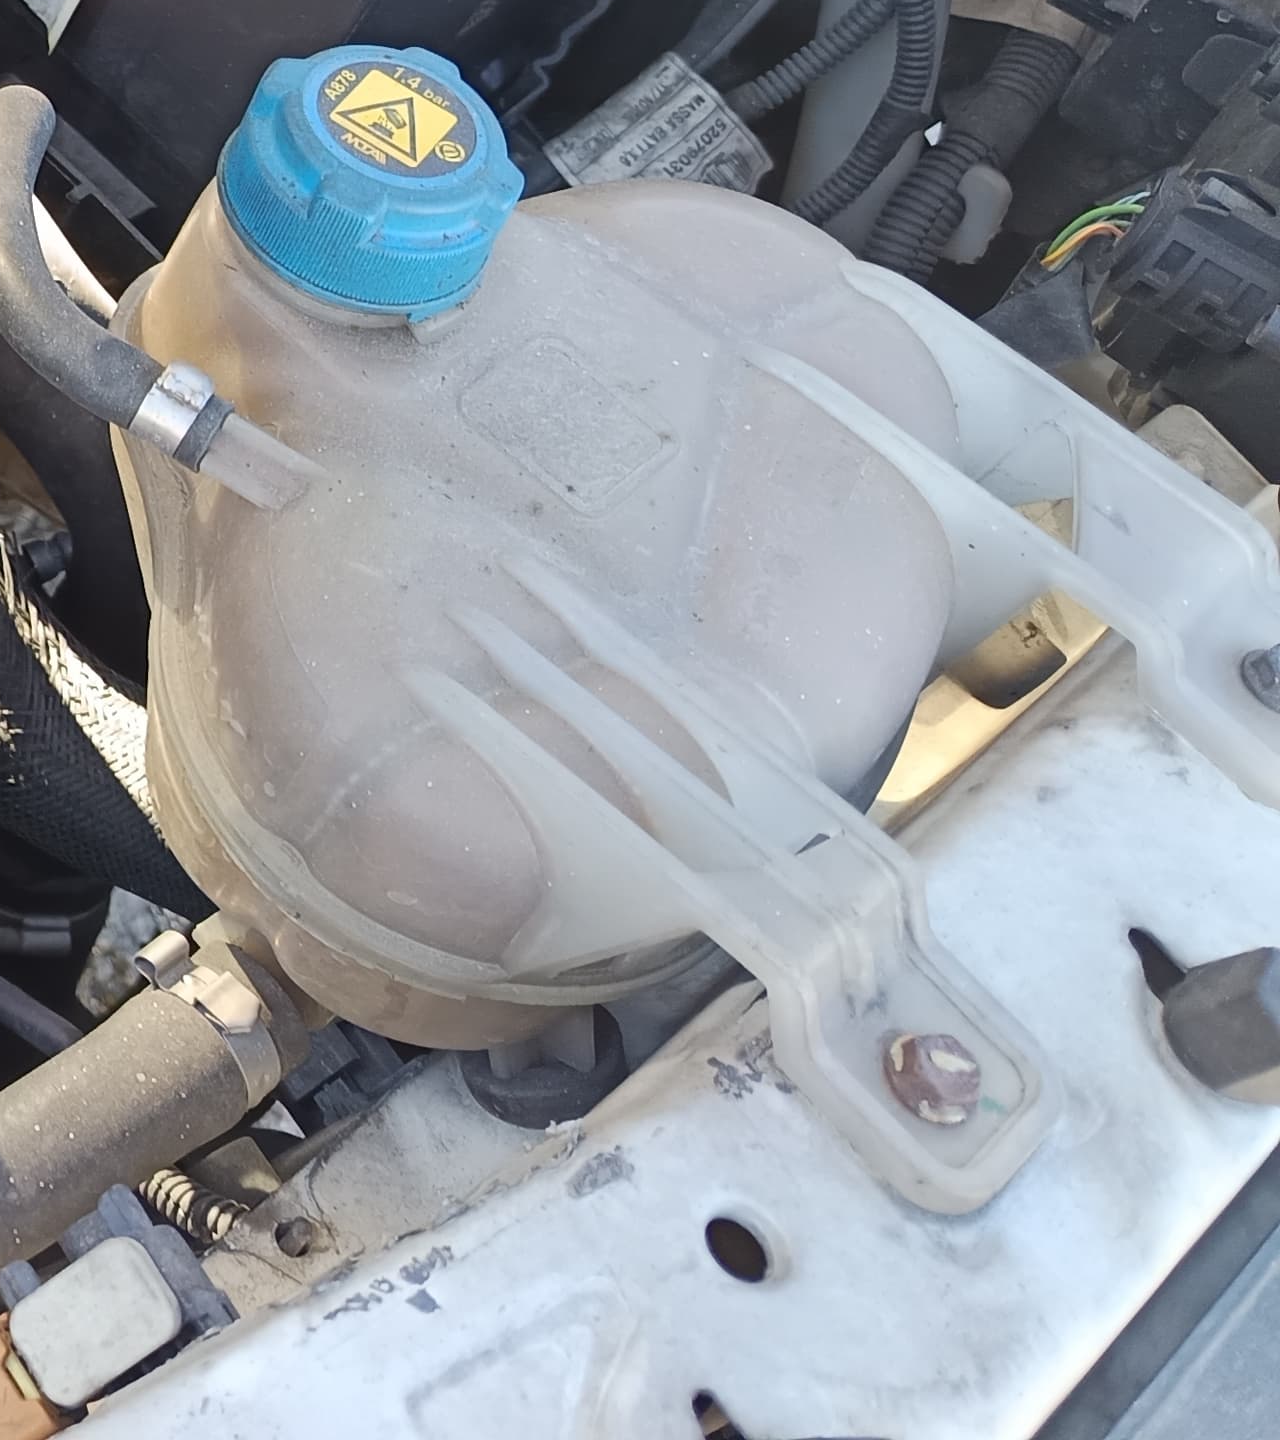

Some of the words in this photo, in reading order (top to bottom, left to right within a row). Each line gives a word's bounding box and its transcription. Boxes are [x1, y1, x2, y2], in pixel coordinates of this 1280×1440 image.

[324, 68, 357, 101] A878
[391, 66, 422, 90] 1.4
[423, 87, 450, 108] bar
[666, 93, 707, 132] MASSA
[662, 117, 728, 178] 52079031
